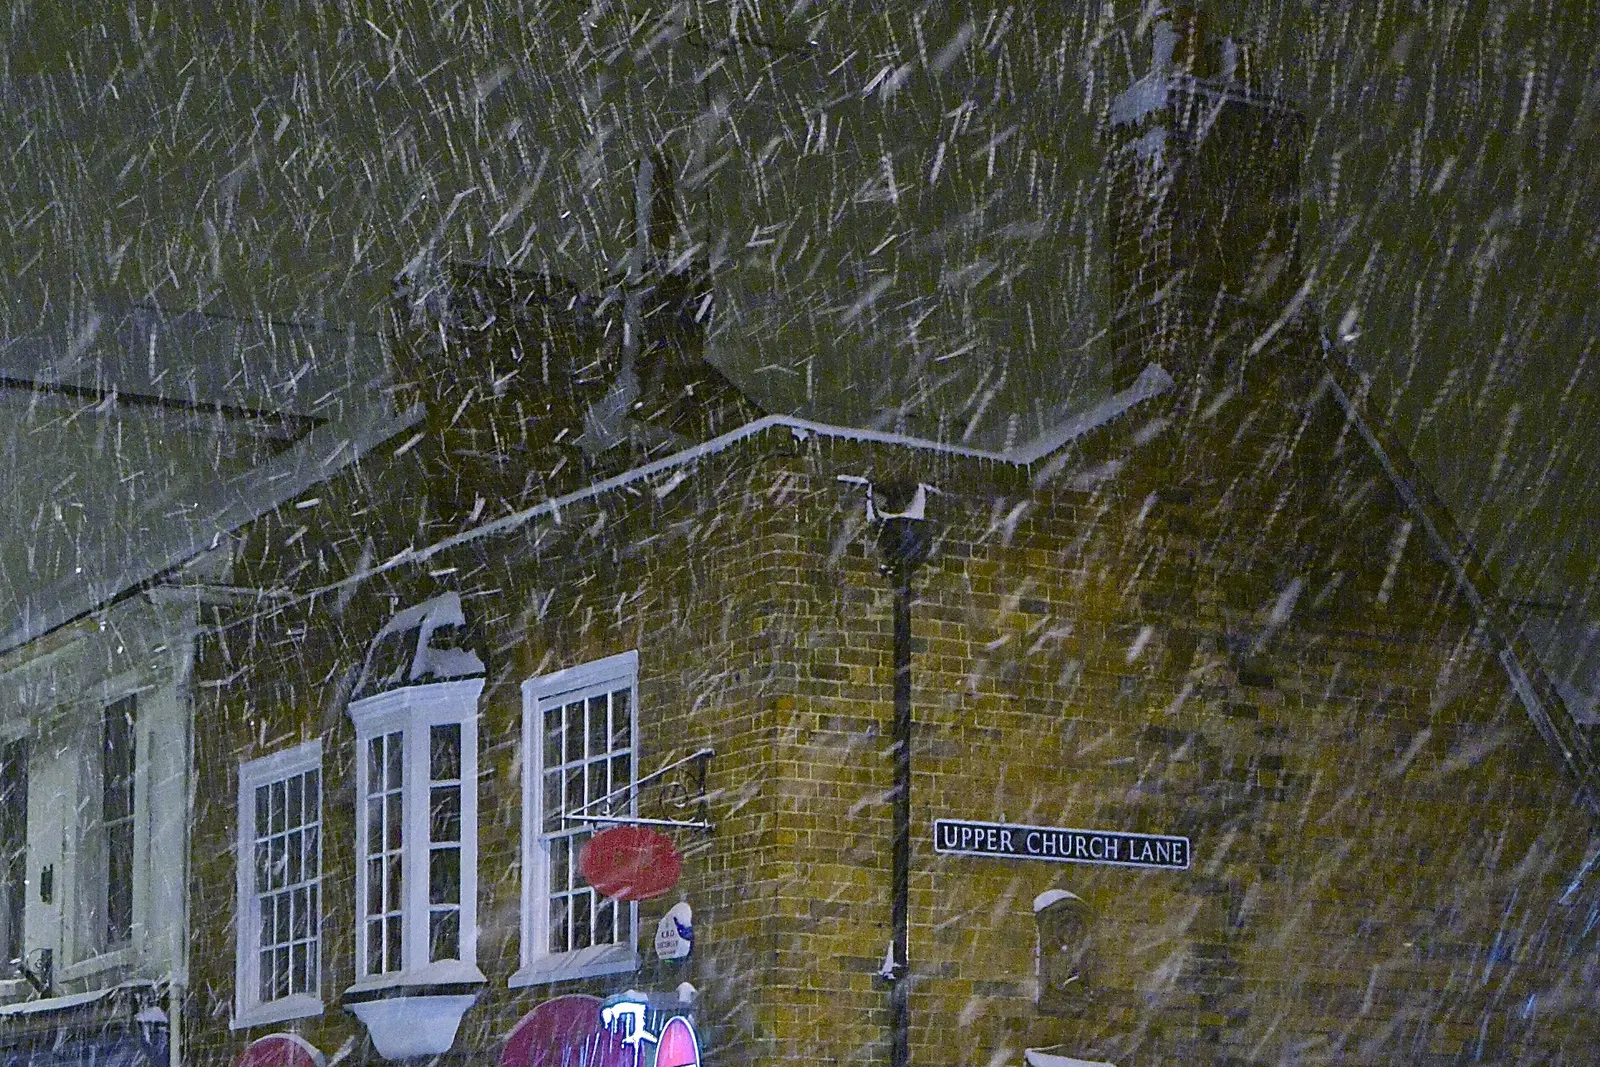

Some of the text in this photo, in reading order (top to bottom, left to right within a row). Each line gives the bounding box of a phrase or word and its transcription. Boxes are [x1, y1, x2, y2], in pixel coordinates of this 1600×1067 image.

[943, 826, 1182, 864] UPPER CHURCH LANE
